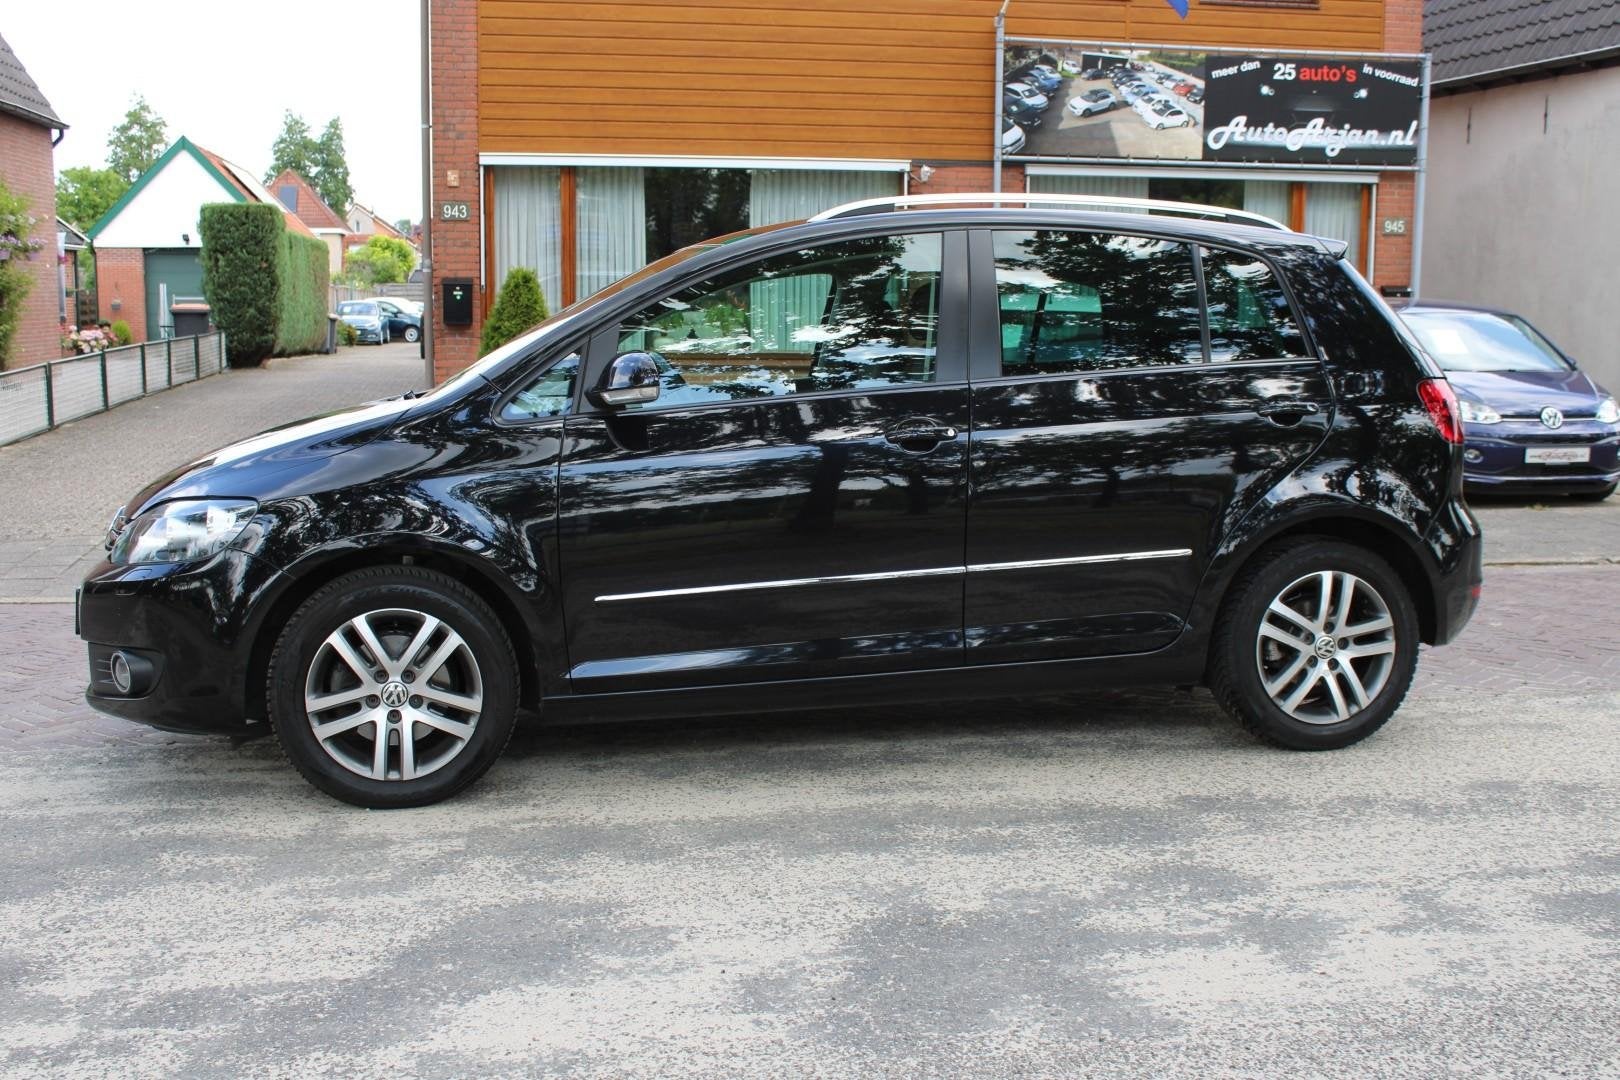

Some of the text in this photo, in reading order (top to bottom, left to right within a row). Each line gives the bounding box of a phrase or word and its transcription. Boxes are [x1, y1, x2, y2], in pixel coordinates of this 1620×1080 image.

[1211, 60, 1419, 87] meer dan 25 auto's in voorraad
[443, 205, 467, 218] 943
[1384, 220, 1405, 233] 945
